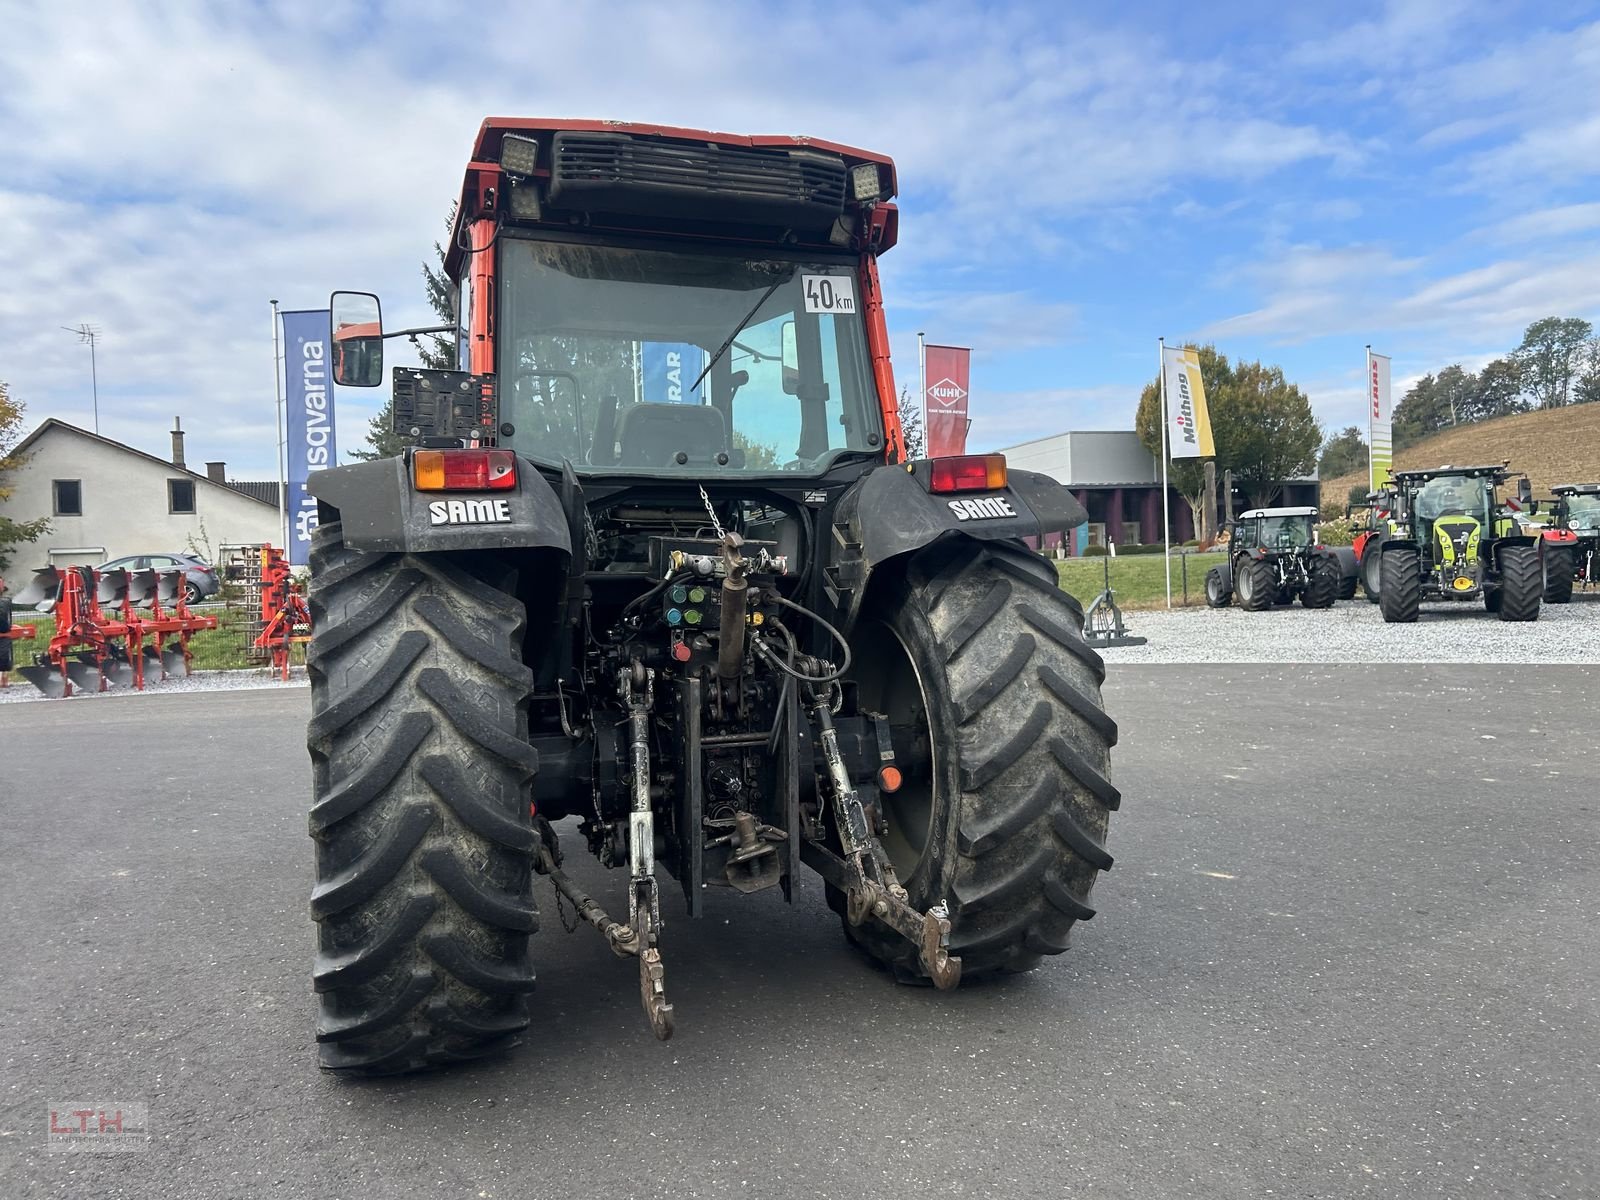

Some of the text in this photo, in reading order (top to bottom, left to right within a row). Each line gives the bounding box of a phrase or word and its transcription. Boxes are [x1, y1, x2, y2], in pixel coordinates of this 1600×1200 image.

[807, 279, 853, 309] 40 km
[933, 387, 960, 398] KUHN
[428, 499, 511, 524] SAME
[948, 496, 1017, 520] SAME
